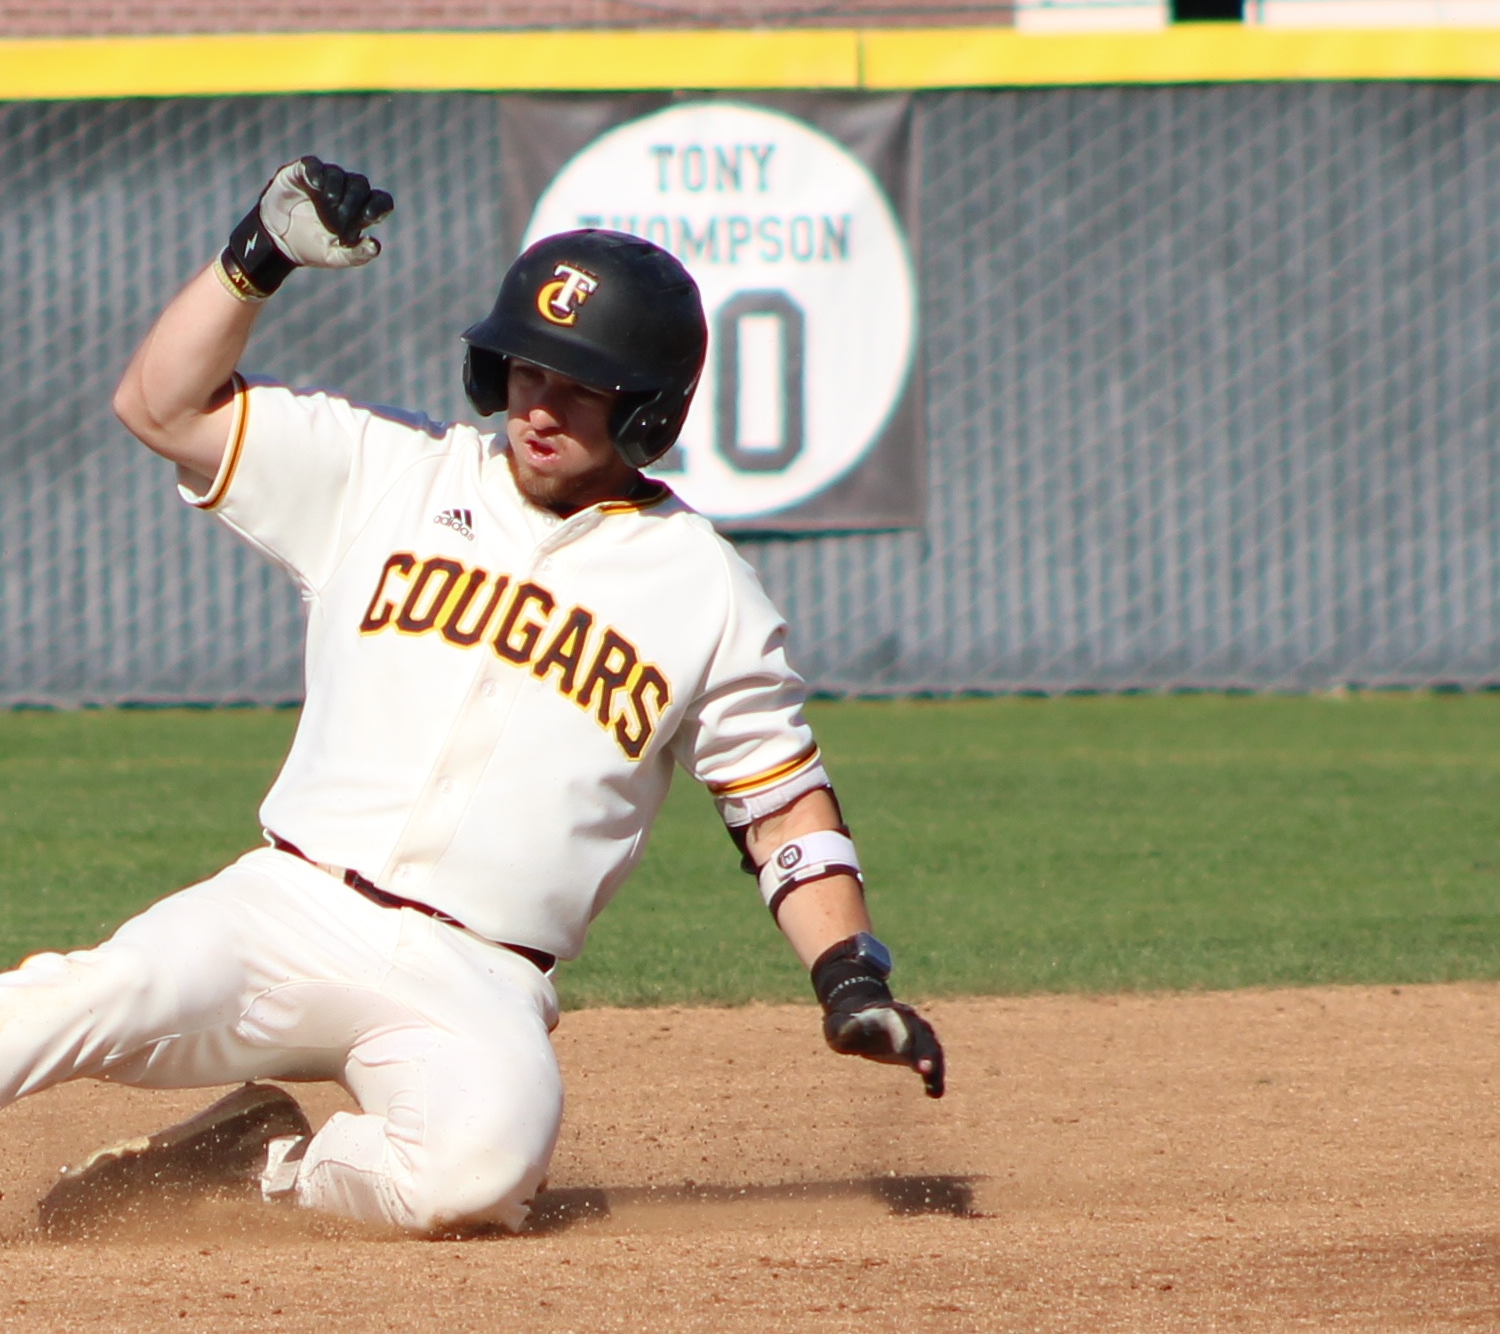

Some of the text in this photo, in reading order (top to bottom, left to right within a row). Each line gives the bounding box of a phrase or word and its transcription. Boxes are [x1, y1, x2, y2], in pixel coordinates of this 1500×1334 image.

[649, 144, 777, 194] TONY
[433, 514, 475, 541] adidas
[359, 550, 674, 762] COUGARS
